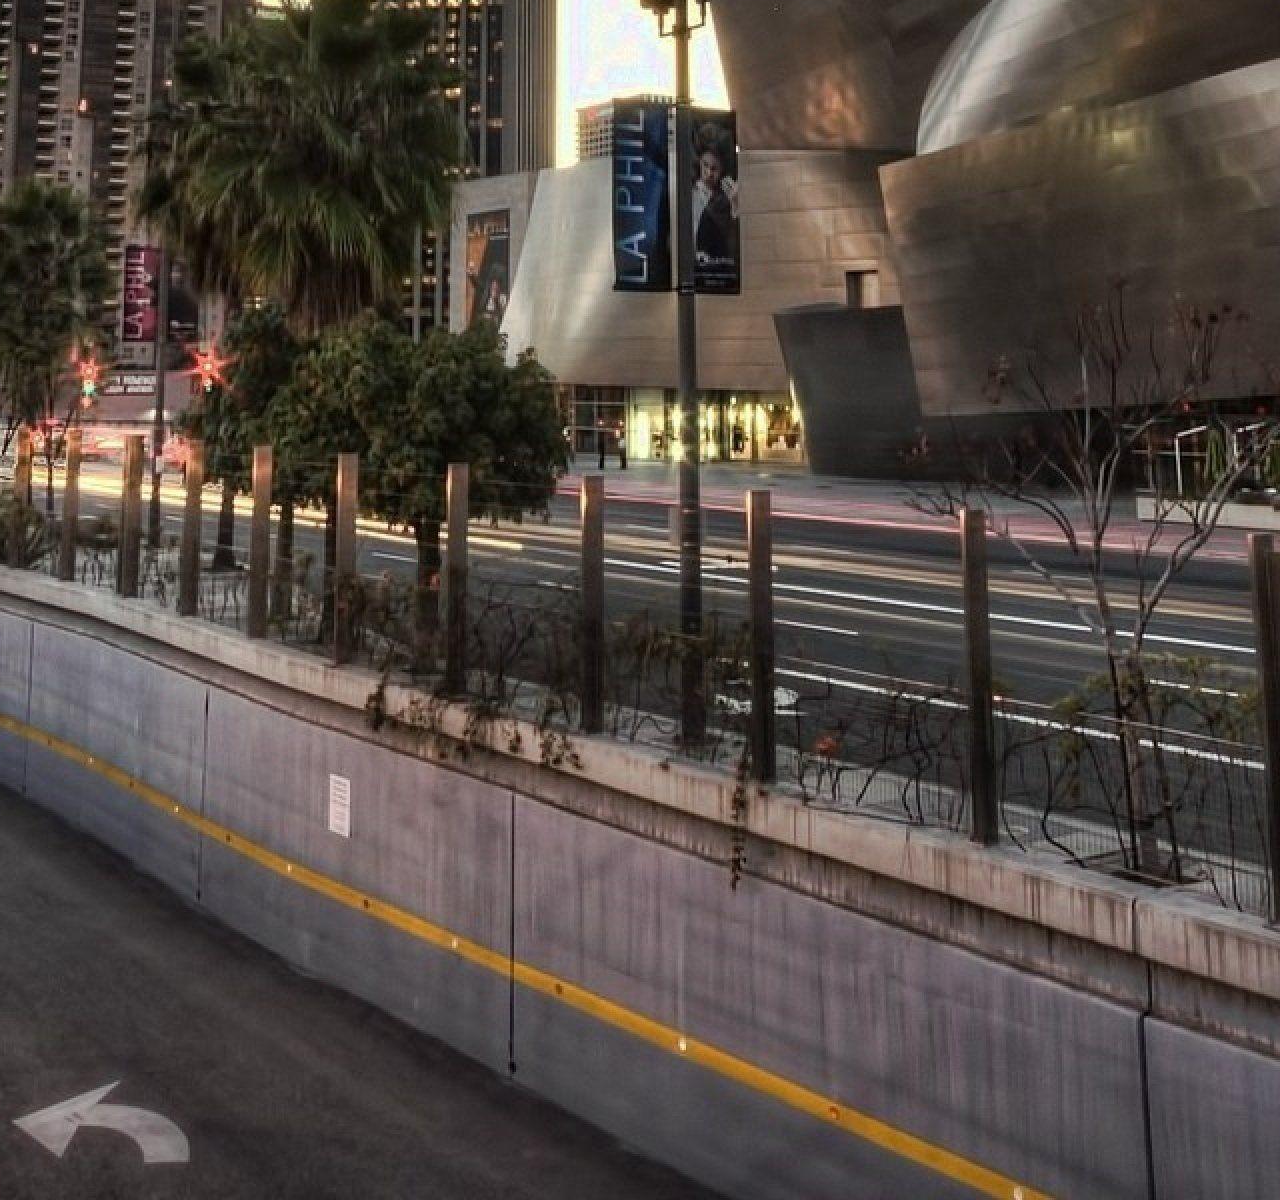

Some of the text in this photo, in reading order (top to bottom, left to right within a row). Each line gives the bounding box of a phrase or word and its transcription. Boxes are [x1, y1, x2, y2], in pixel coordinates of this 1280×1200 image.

[616, 109, 649, 283] LA PHIL
[124, 251, 145, 339] LA PHIL
